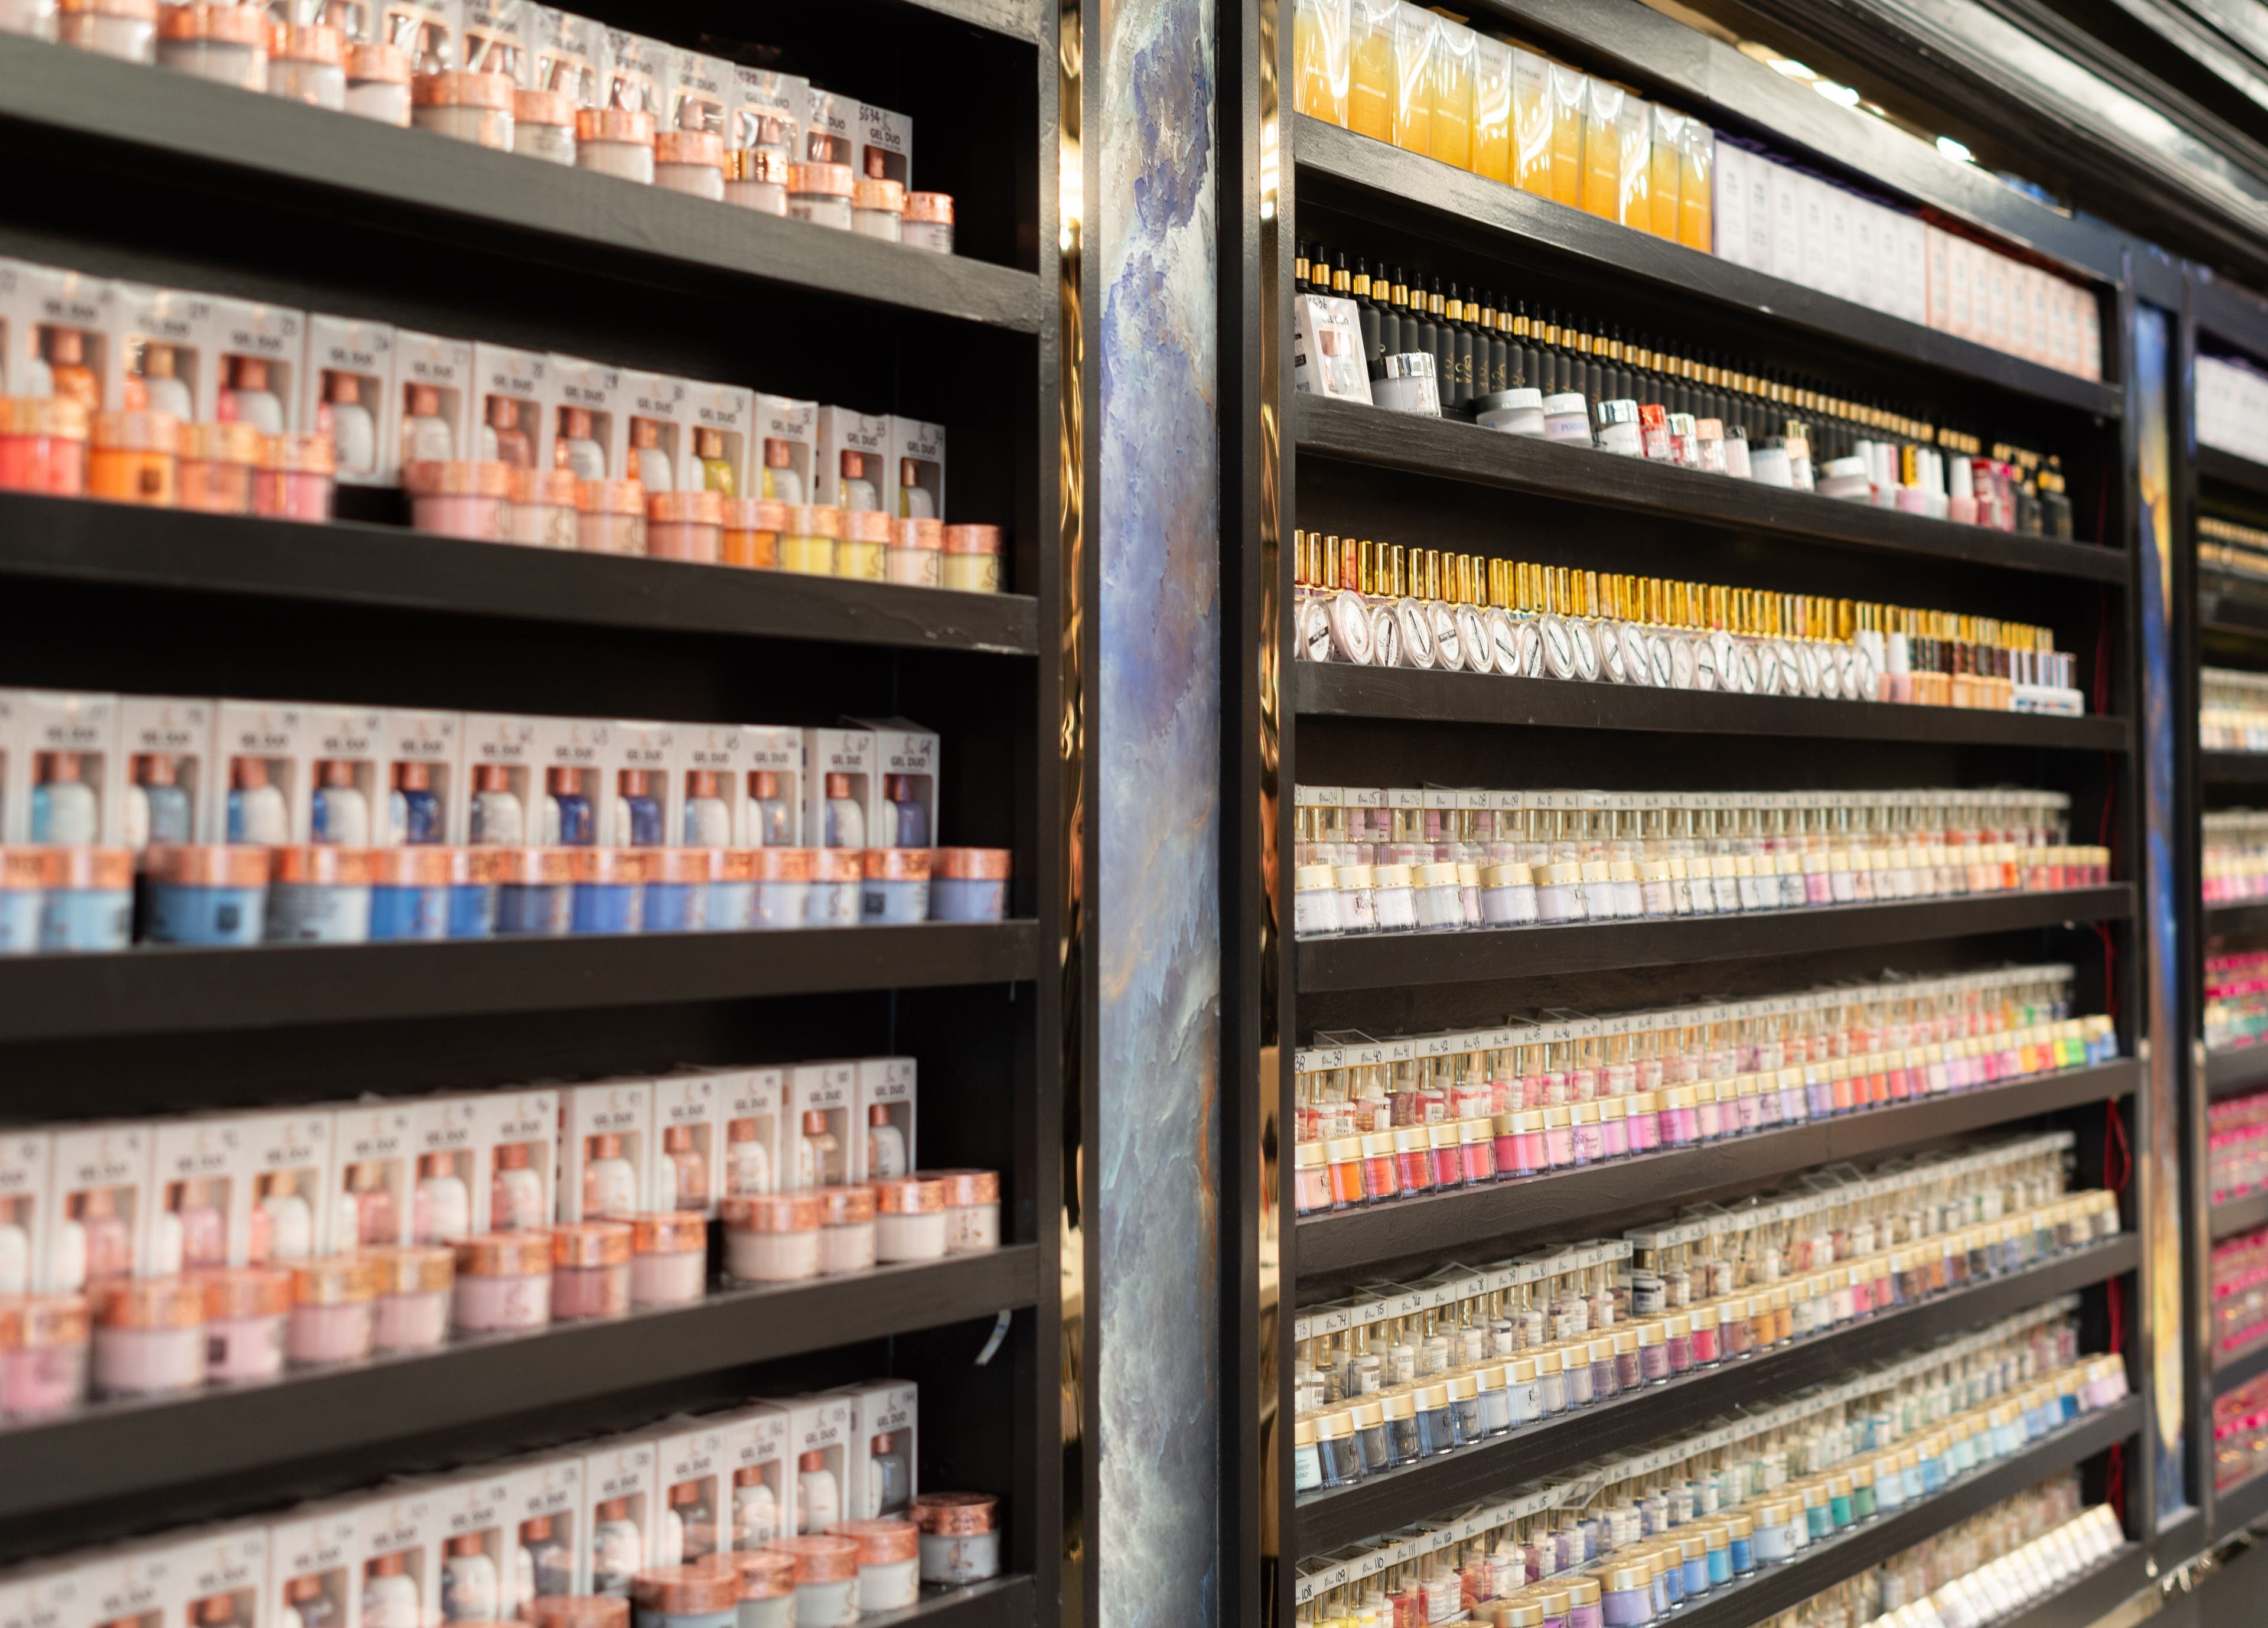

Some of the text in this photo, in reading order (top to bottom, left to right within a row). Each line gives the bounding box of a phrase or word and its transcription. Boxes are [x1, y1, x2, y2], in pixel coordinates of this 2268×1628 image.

[871, 128, 901, 145] GEL DUO
[771, 421, 804, 435] GEL DUO
[847, 432, 878, 447] GEL DUO
[907, 441, 936, 455] GEL DUO
[832, 755, 862, 766] GEL DUO
[891, 756, 926, 767] GEL DUO
[1329, 792, 1337, 806] 04
[1478, 793, 1487, 807] 08
[1503, 1034, 1509, 1046] 44
[1533, 1026, 1541, 1040] 45
[1440, 1040, 1449, 1051] 42
[1473, 1036, 1480, 1049] 43
[1373, 1049, 1382, 1063] 40
[1403, 1044, 1410, 1058] 41
[1295, 1054, 1305, 1073] 38
[1332, 1050, 1342, 1067] 39
[875, 1084, 905, 1096] GEL DUO
[1376, 1303, 1384, 1316] 75
[1337, 1313, 1347, 1326] 74
[878, 1412, 907, 1427] GEL DUO
[1538, 1495, 1547, 1509] 115
[1374, 1557, 1384, 1570] 110
[1335, 1569, 1346, 1583] 109
[1301, 1584, 1312, 1601] 108
